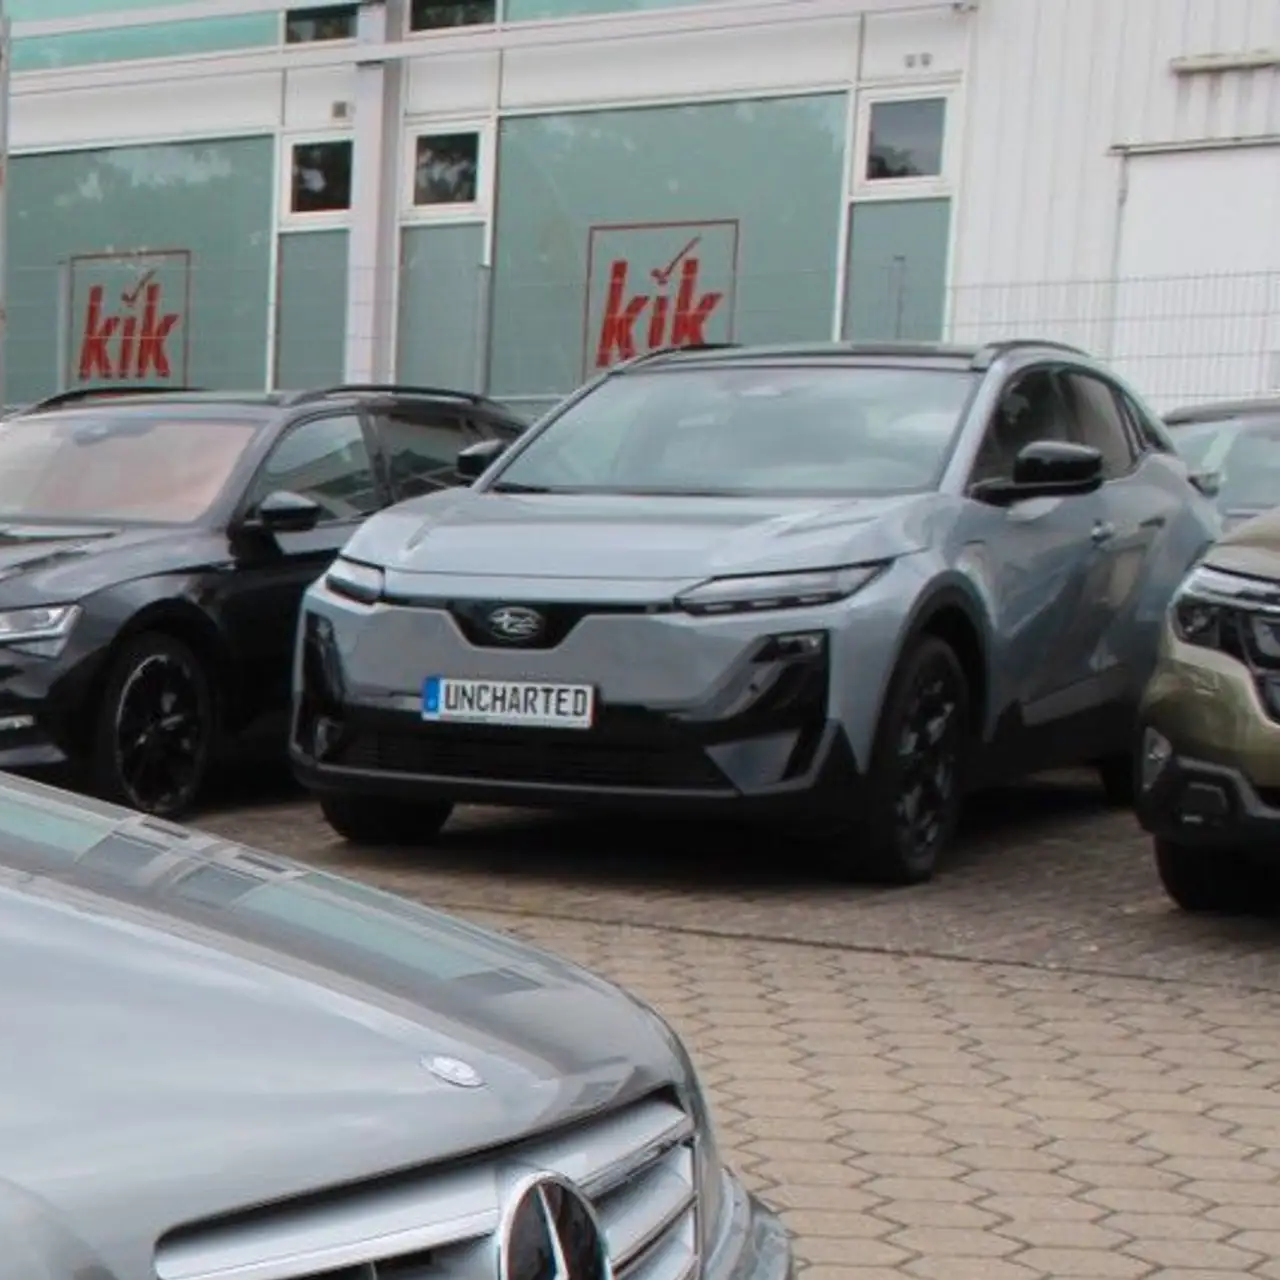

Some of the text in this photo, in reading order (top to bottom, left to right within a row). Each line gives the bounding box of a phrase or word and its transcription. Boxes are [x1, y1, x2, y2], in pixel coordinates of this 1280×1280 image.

[79, 269, 179, 380] kik
[596, 235, 723, 367] kik
[445, 684, 587, 717] UNCHARTED
